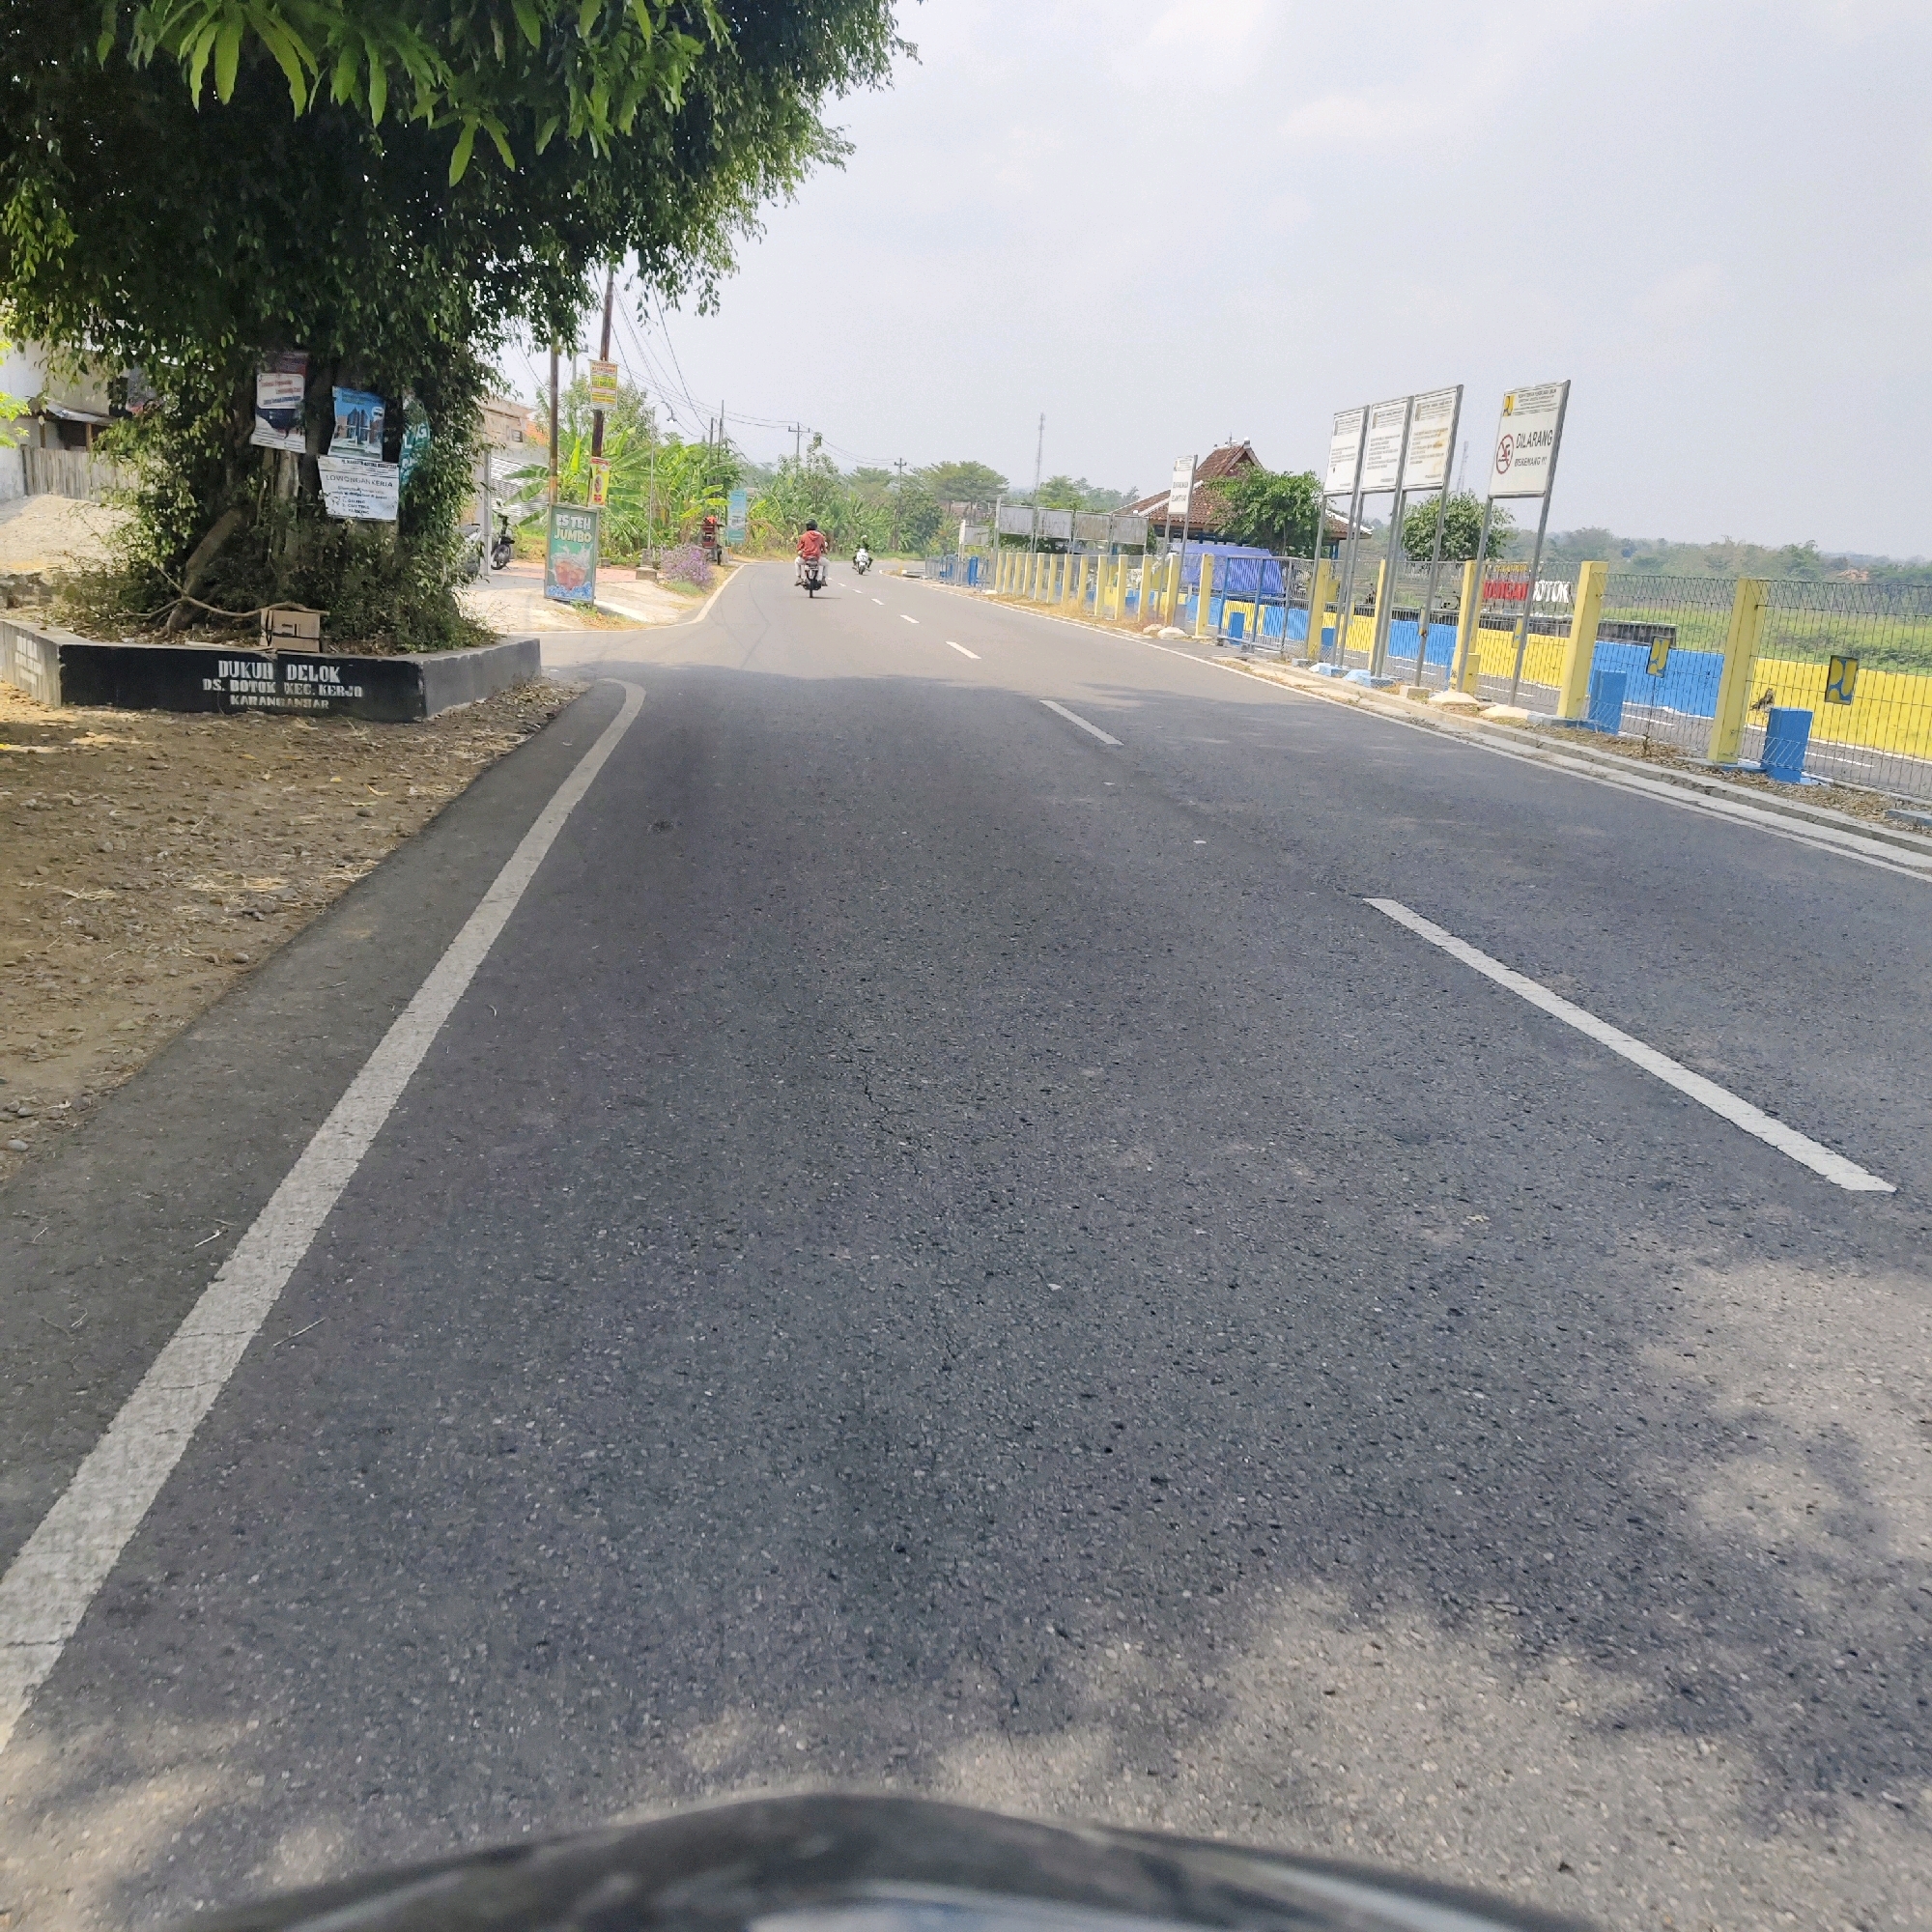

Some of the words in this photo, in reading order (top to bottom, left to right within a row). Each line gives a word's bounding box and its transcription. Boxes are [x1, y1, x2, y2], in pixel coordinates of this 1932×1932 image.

[1516, 429, 1553, 449] DILARANG
[326, 474, 370, 484] LOWONGAN
[371, 479, 393, 488] KERJA
[555, 513, 570, 527] ES
[570, 515, 592, 530] TEH
[554, 527, 593, 543] JUMBO
[217, 660, 274, 680] DUKUH
[286, 664, 341, 684] DELOK
[202, 678, 225, 692] DS.
[229, 679, 276, 694] BOTOK
[283, 682, 316, 696] KEC.
[318, 684, 363, 697] KERJO
